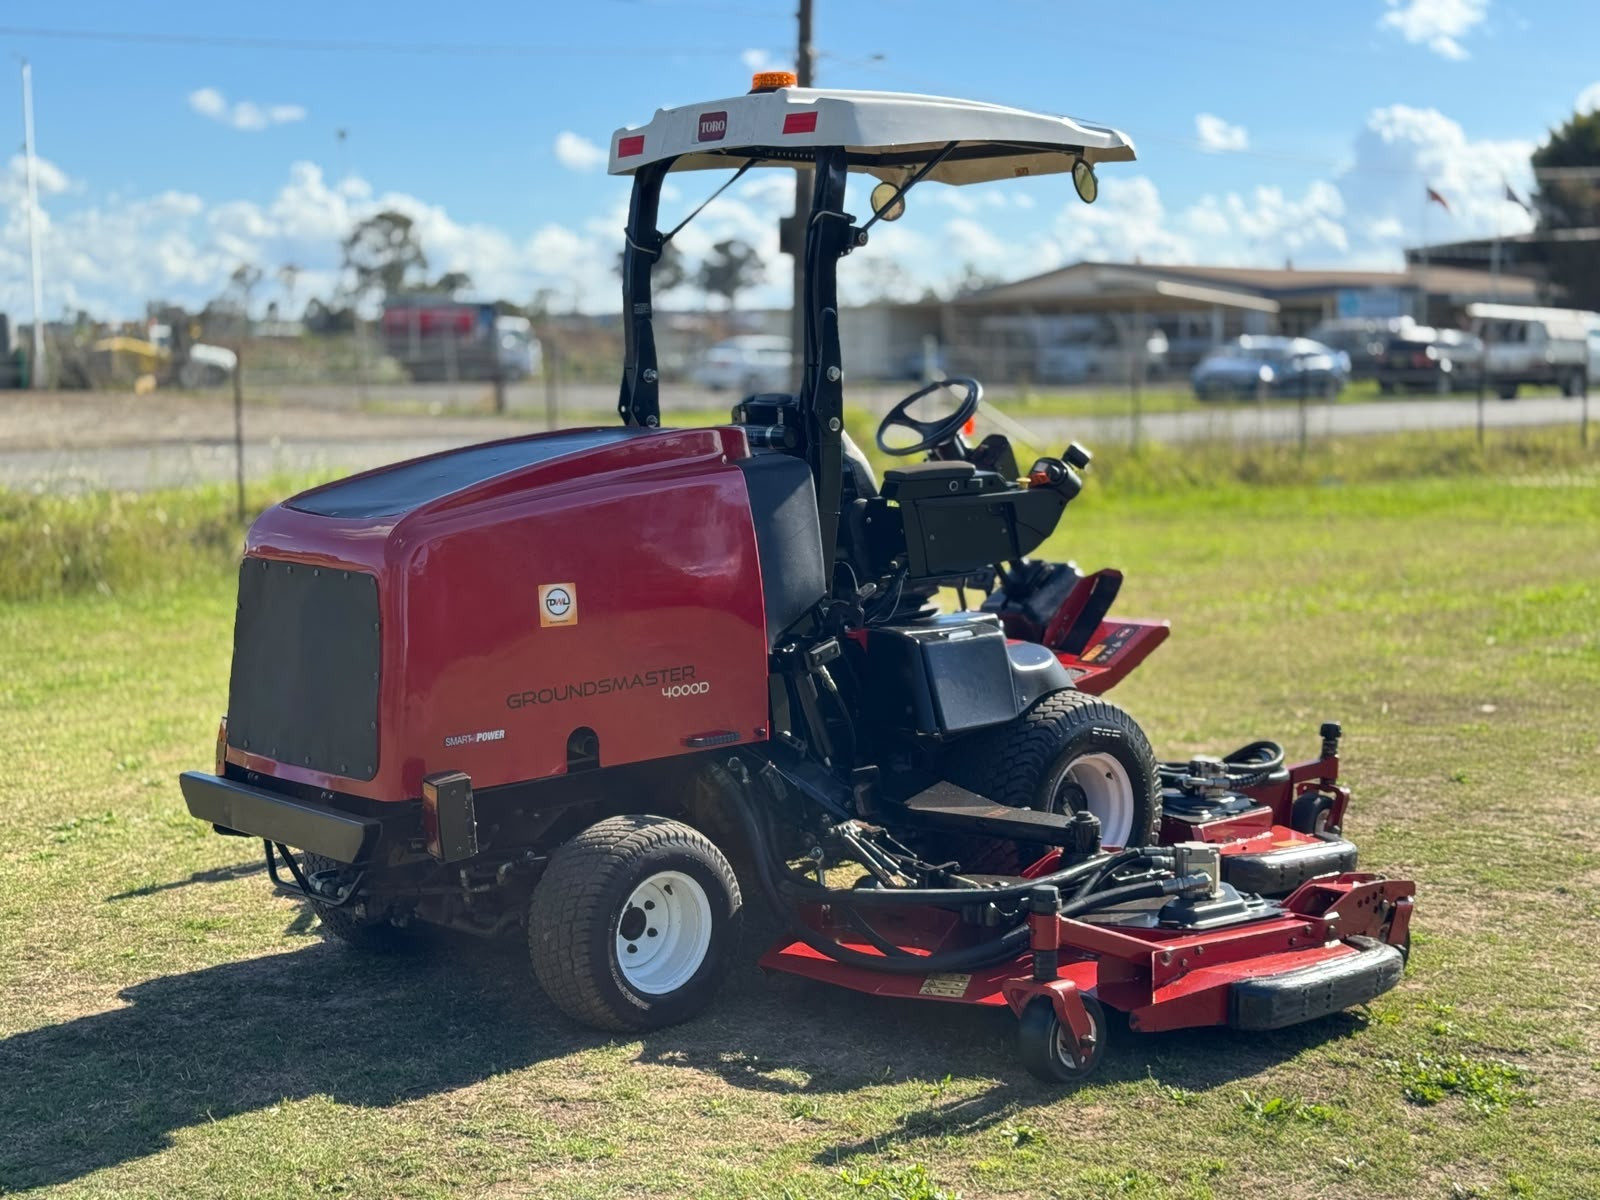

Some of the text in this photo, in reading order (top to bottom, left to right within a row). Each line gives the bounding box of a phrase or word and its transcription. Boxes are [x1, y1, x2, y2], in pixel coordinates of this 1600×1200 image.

[701, 120, 725, 133] TORO
[506, 665, 696, 709] GROUNDSMASTER
[662, 681, 710, 698] 4000D
[445, 729, 505, 747] SMART POWER
